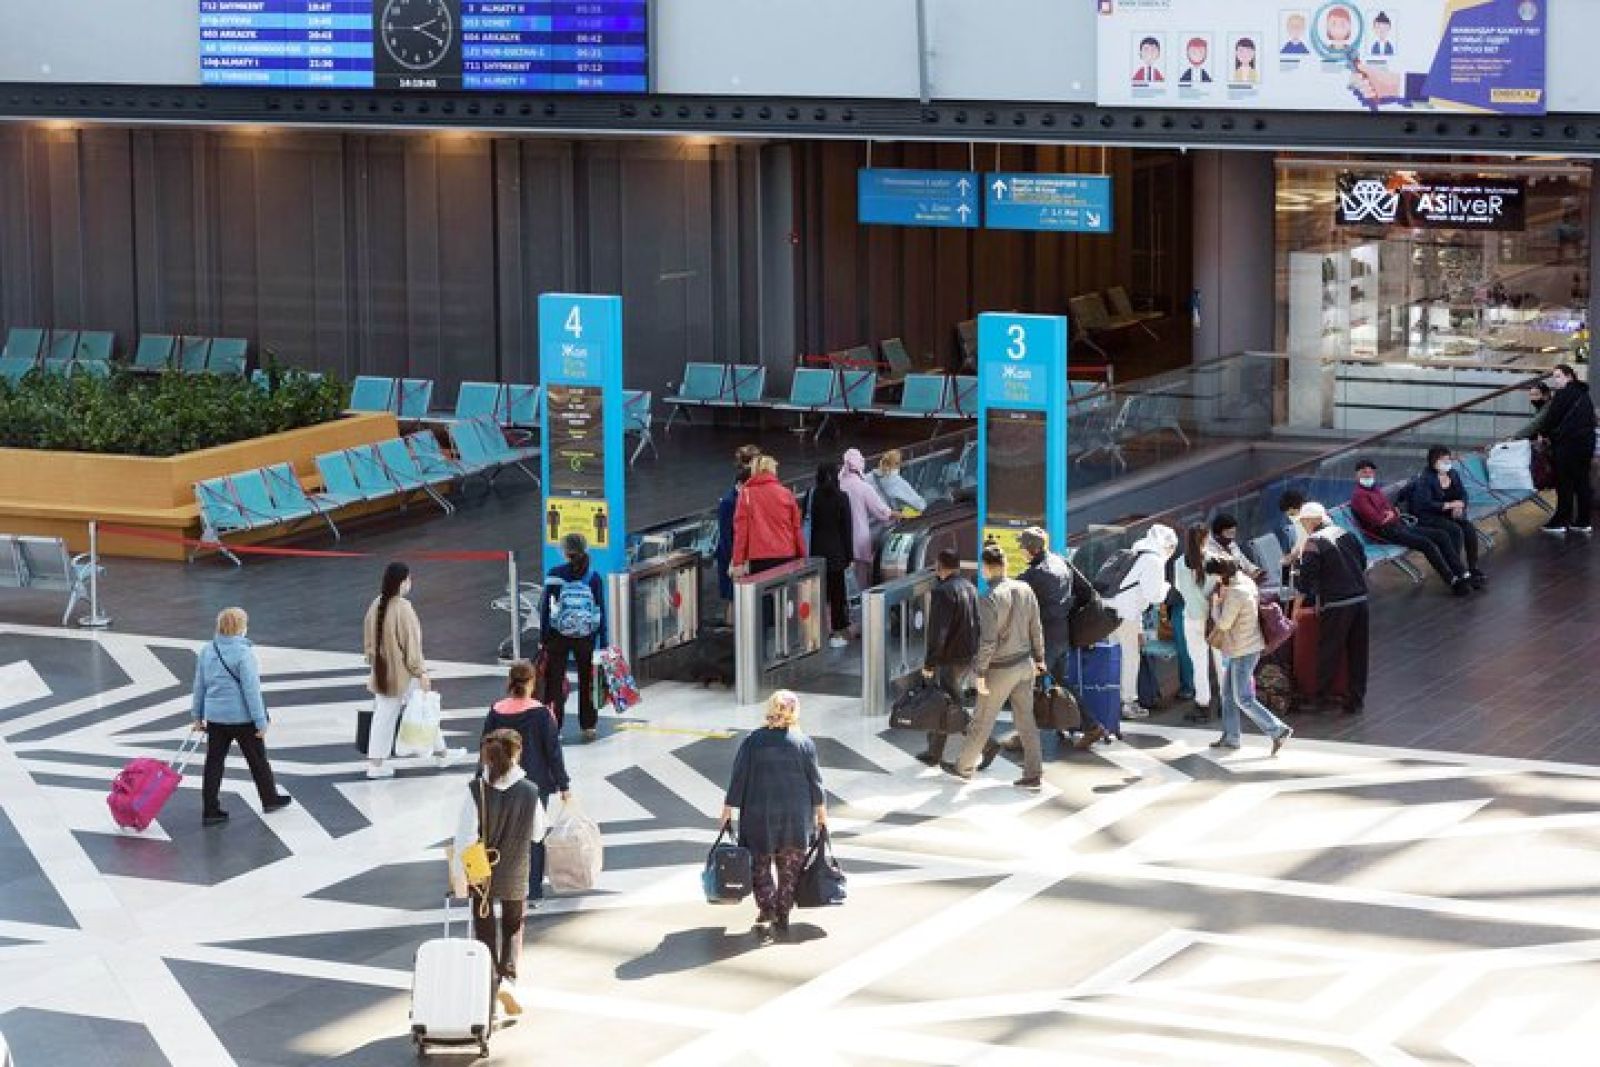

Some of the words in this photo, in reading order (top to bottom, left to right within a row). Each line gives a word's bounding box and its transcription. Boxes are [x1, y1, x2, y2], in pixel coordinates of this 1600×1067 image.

[1417, 193, 1504, 215] ASilveR
[564, 304, 583, 339] 4
[1006, 323, 1026, 360] 3
